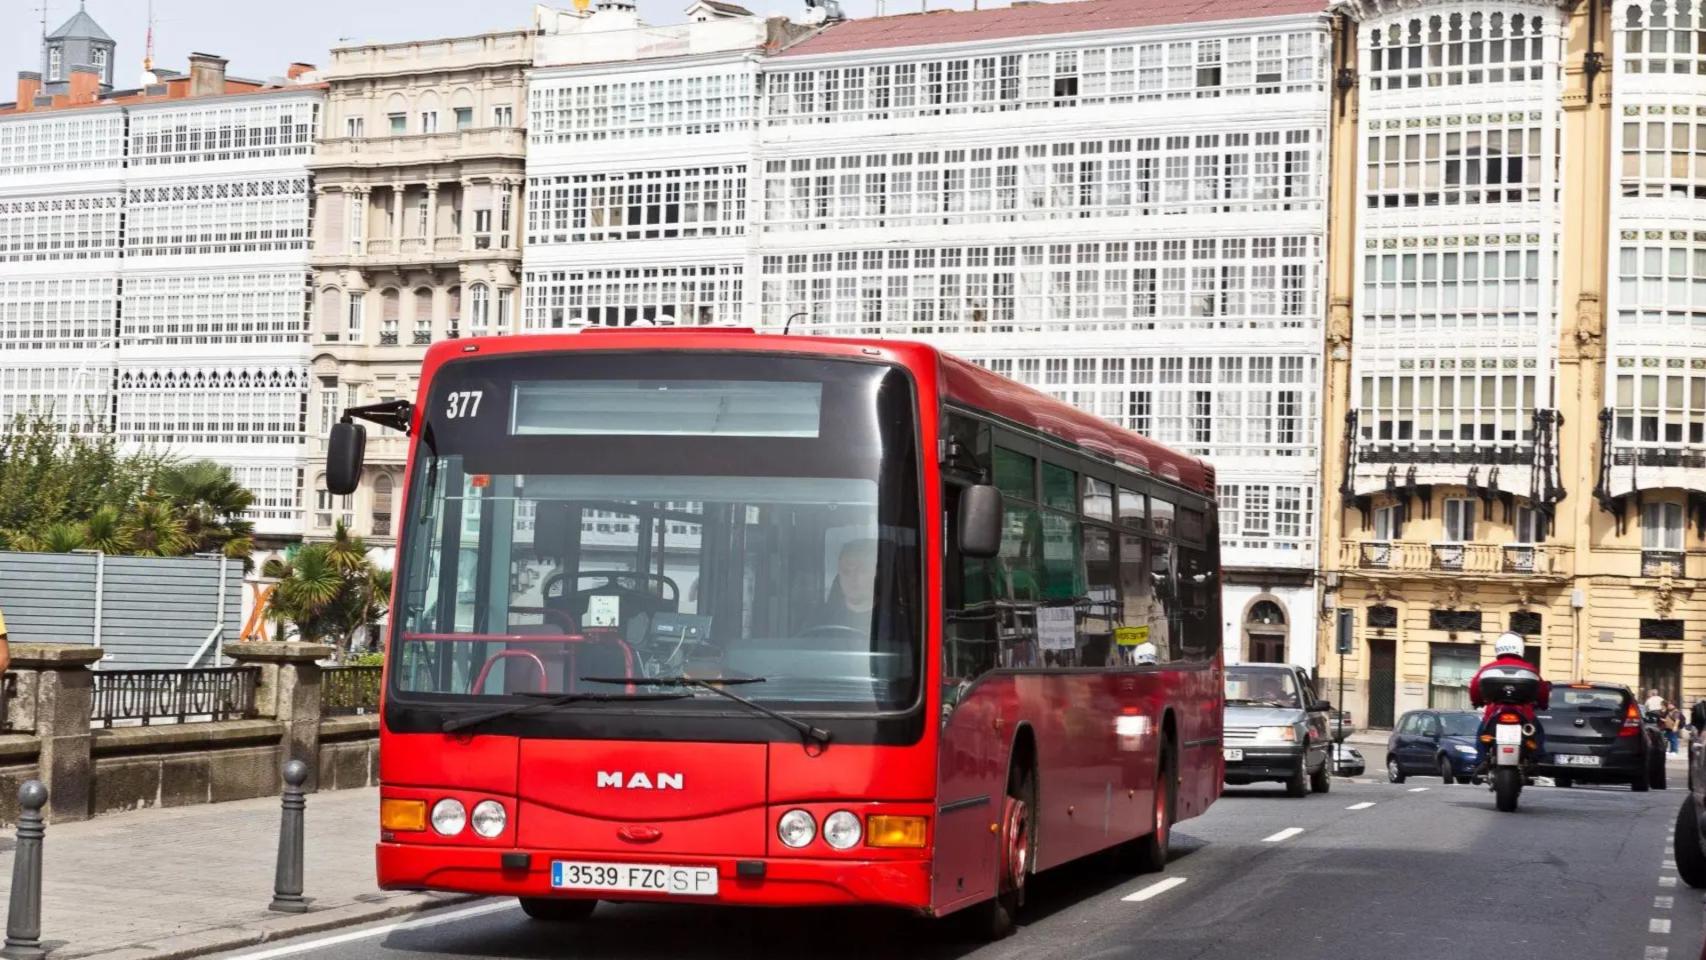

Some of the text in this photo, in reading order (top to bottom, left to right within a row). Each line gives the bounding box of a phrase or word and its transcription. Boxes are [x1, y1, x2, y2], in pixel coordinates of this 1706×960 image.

[446, 391, 483, 419] 377
[597, 771, 683, 789] MAN
[569, 865, 618, 886] 3539
[628, 868, 665, 888] FZC
